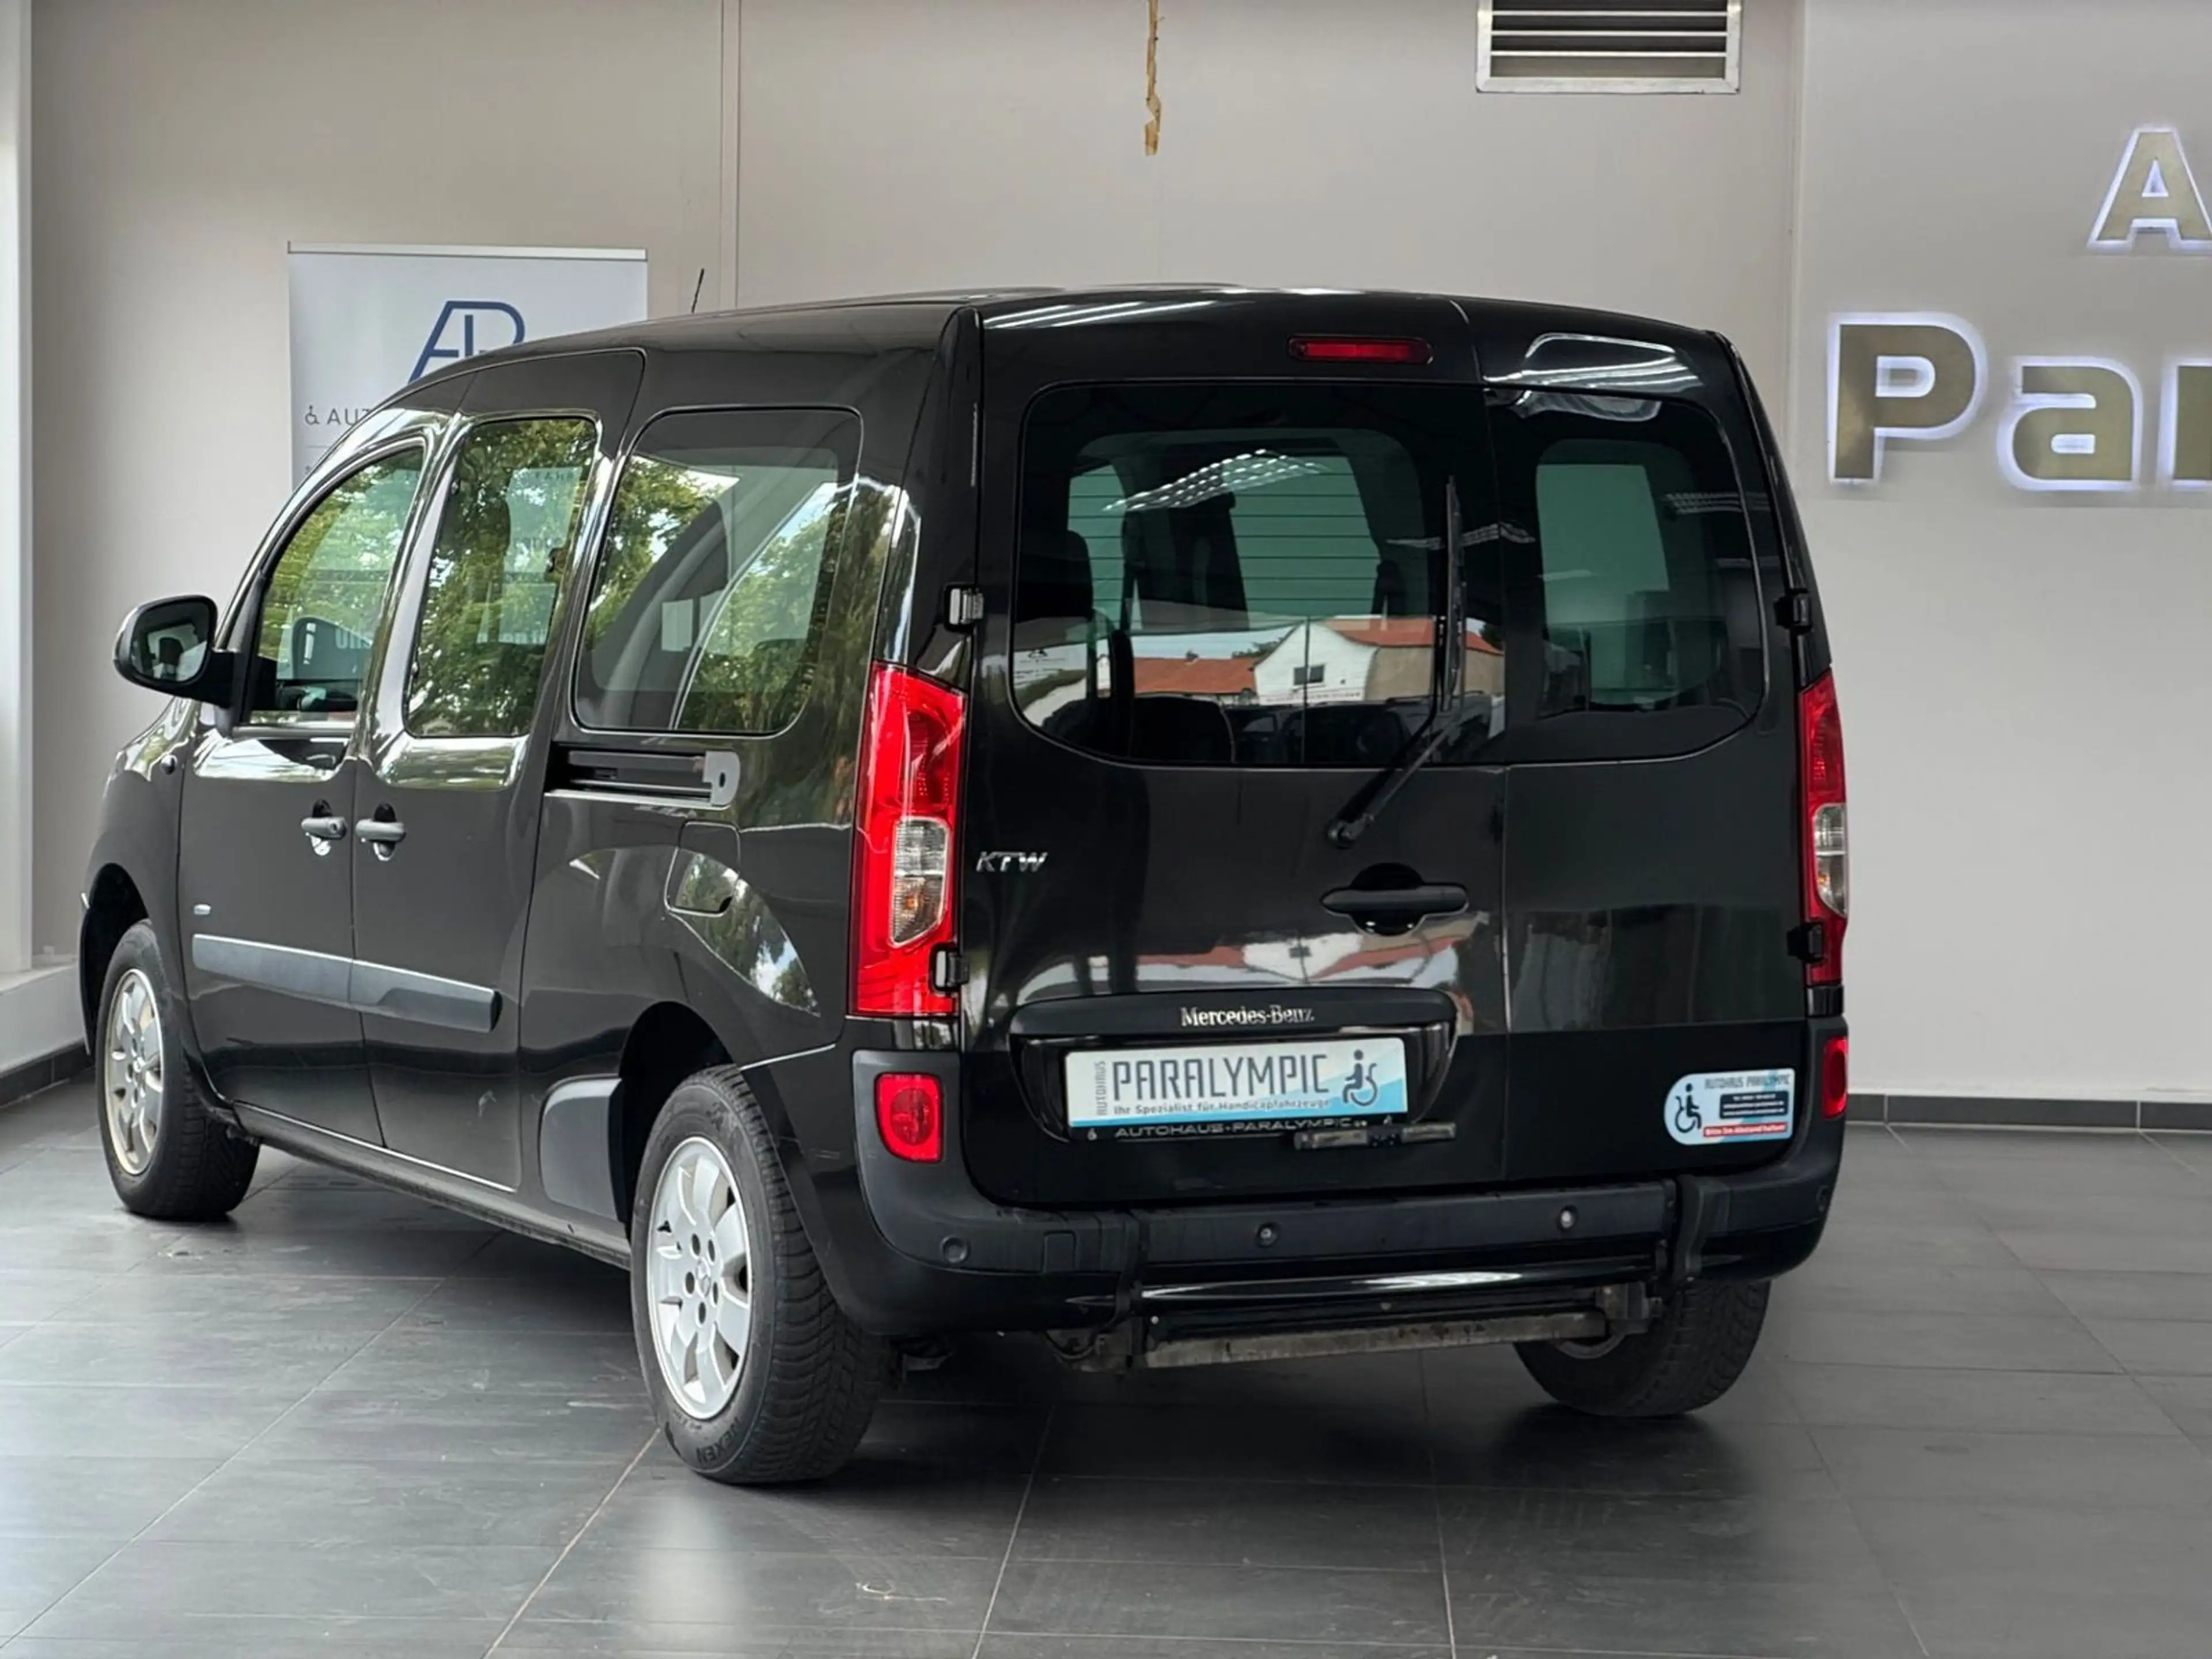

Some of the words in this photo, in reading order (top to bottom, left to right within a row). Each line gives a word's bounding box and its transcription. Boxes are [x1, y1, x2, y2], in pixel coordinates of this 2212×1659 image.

[976, 851, 1048, 872] KTW
[1181, 1005, 1314, 1027] Mercedes-Benz
[1112, 1055, 1330, 1101] PARALYMPIC
[1113, 1106, 1131, 1115] Ihr
[1135, 1104, 1192, 1115] Spezialist
